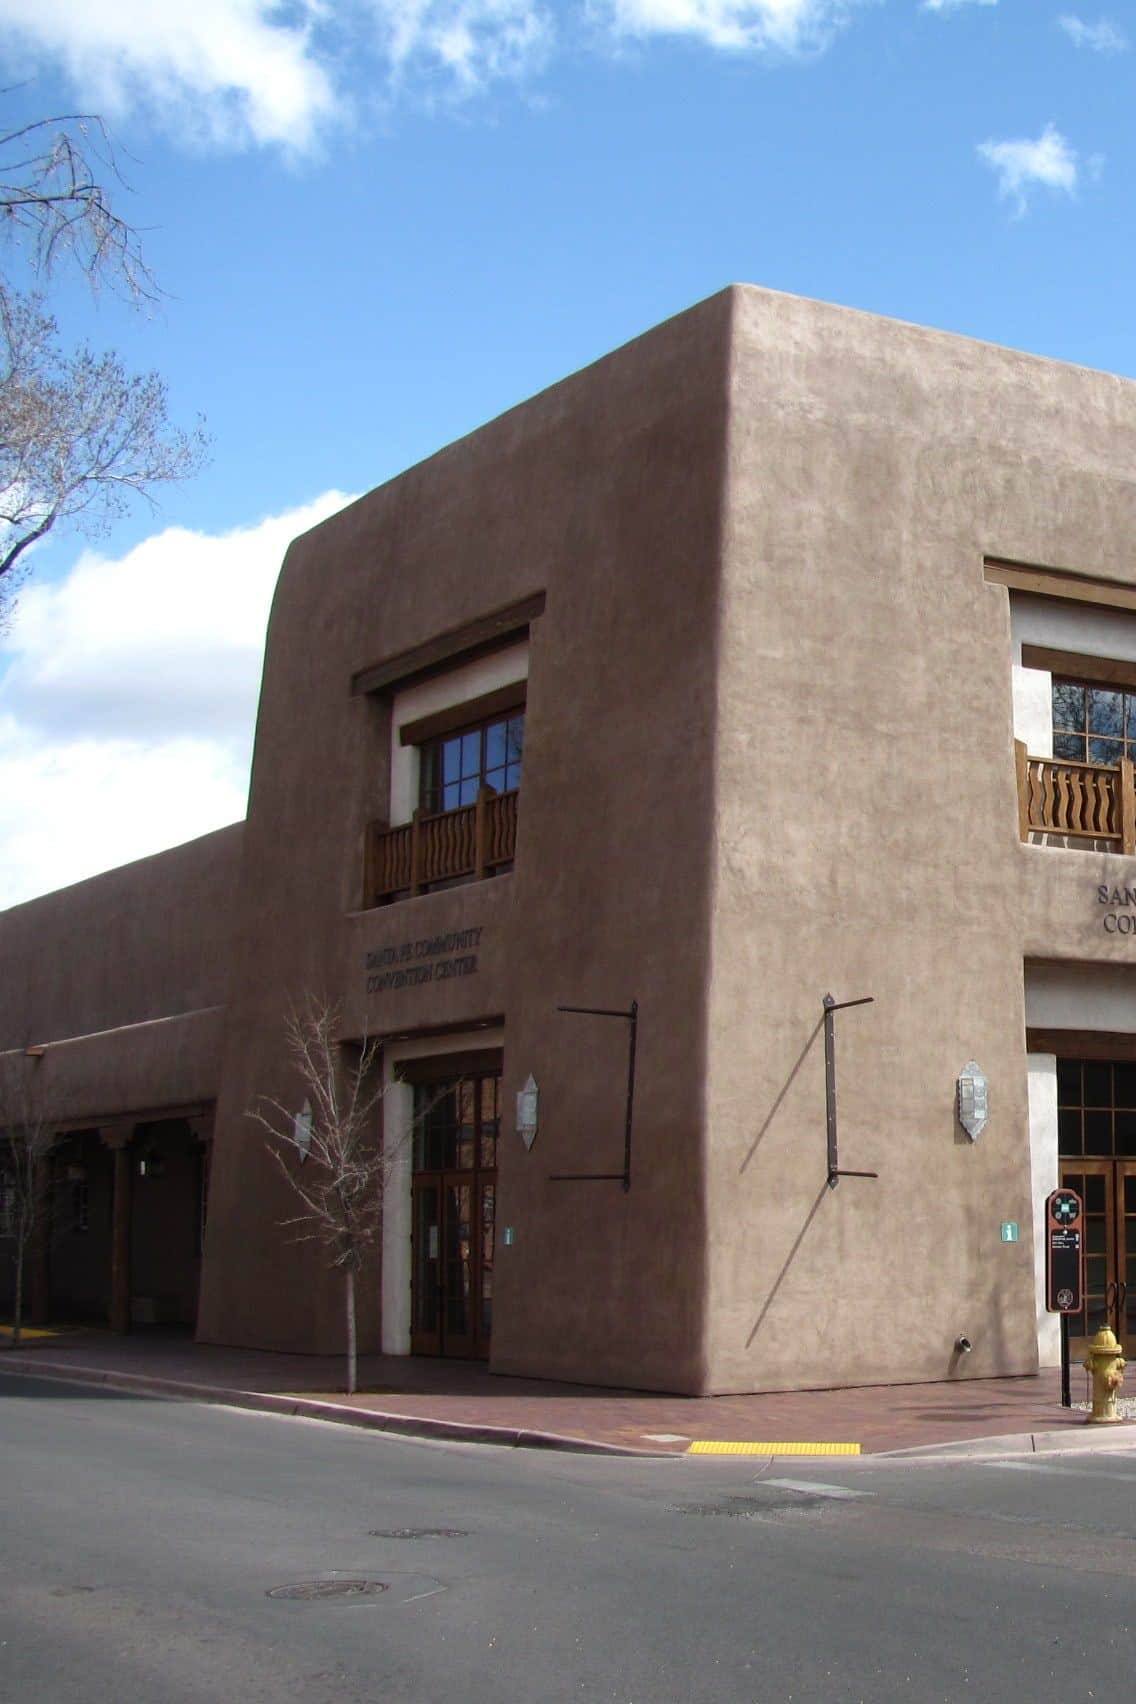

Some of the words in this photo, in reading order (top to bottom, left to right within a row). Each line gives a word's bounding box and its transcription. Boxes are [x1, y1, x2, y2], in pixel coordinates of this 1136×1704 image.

[415, 926, 484, 960] COMMUNITY
[367, 963, 433, 994] CONVENTION
[436, 955, 479, 982] CENTER
